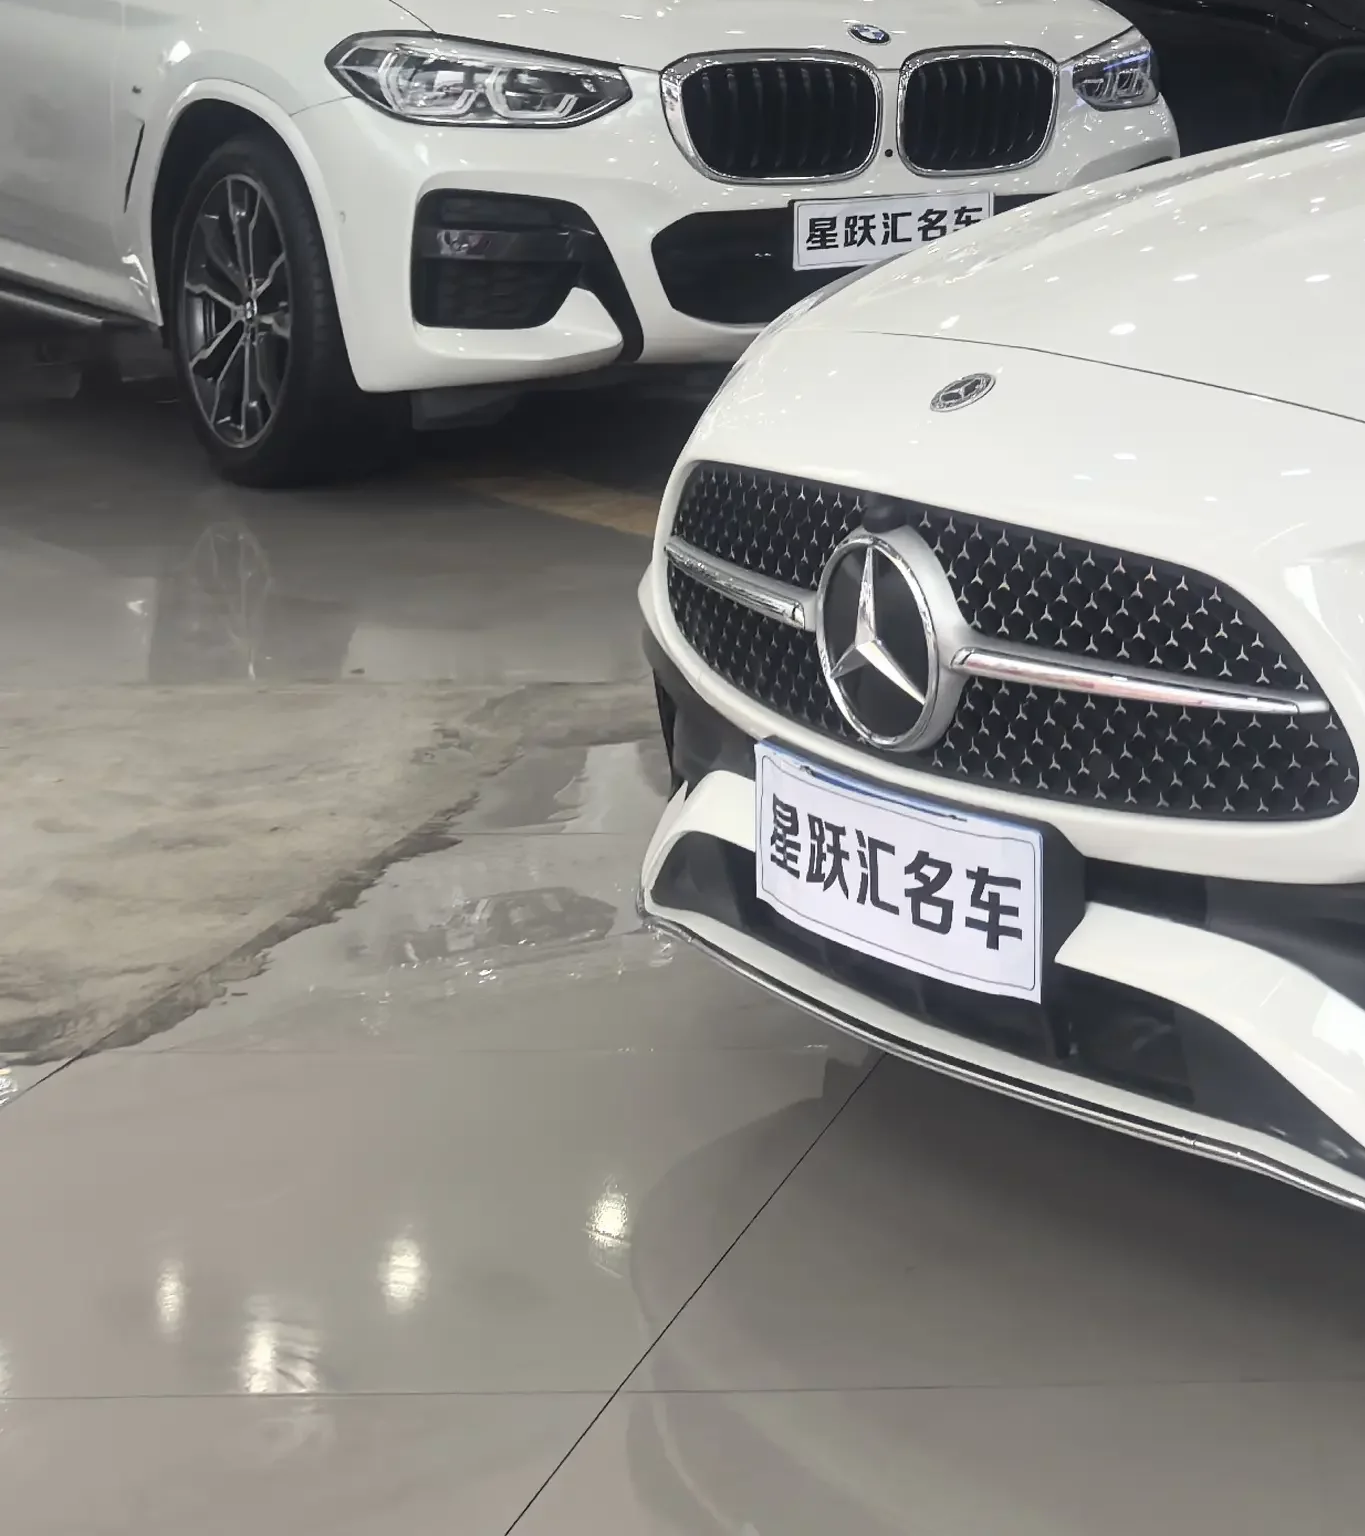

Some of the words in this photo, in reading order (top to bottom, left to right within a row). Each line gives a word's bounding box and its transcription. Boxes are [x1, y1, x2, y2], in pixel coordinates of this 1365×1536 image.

[805, 205, 984, 252] 星跃汇名车
[770, 793, 1024, 951] 星跃汇名车
